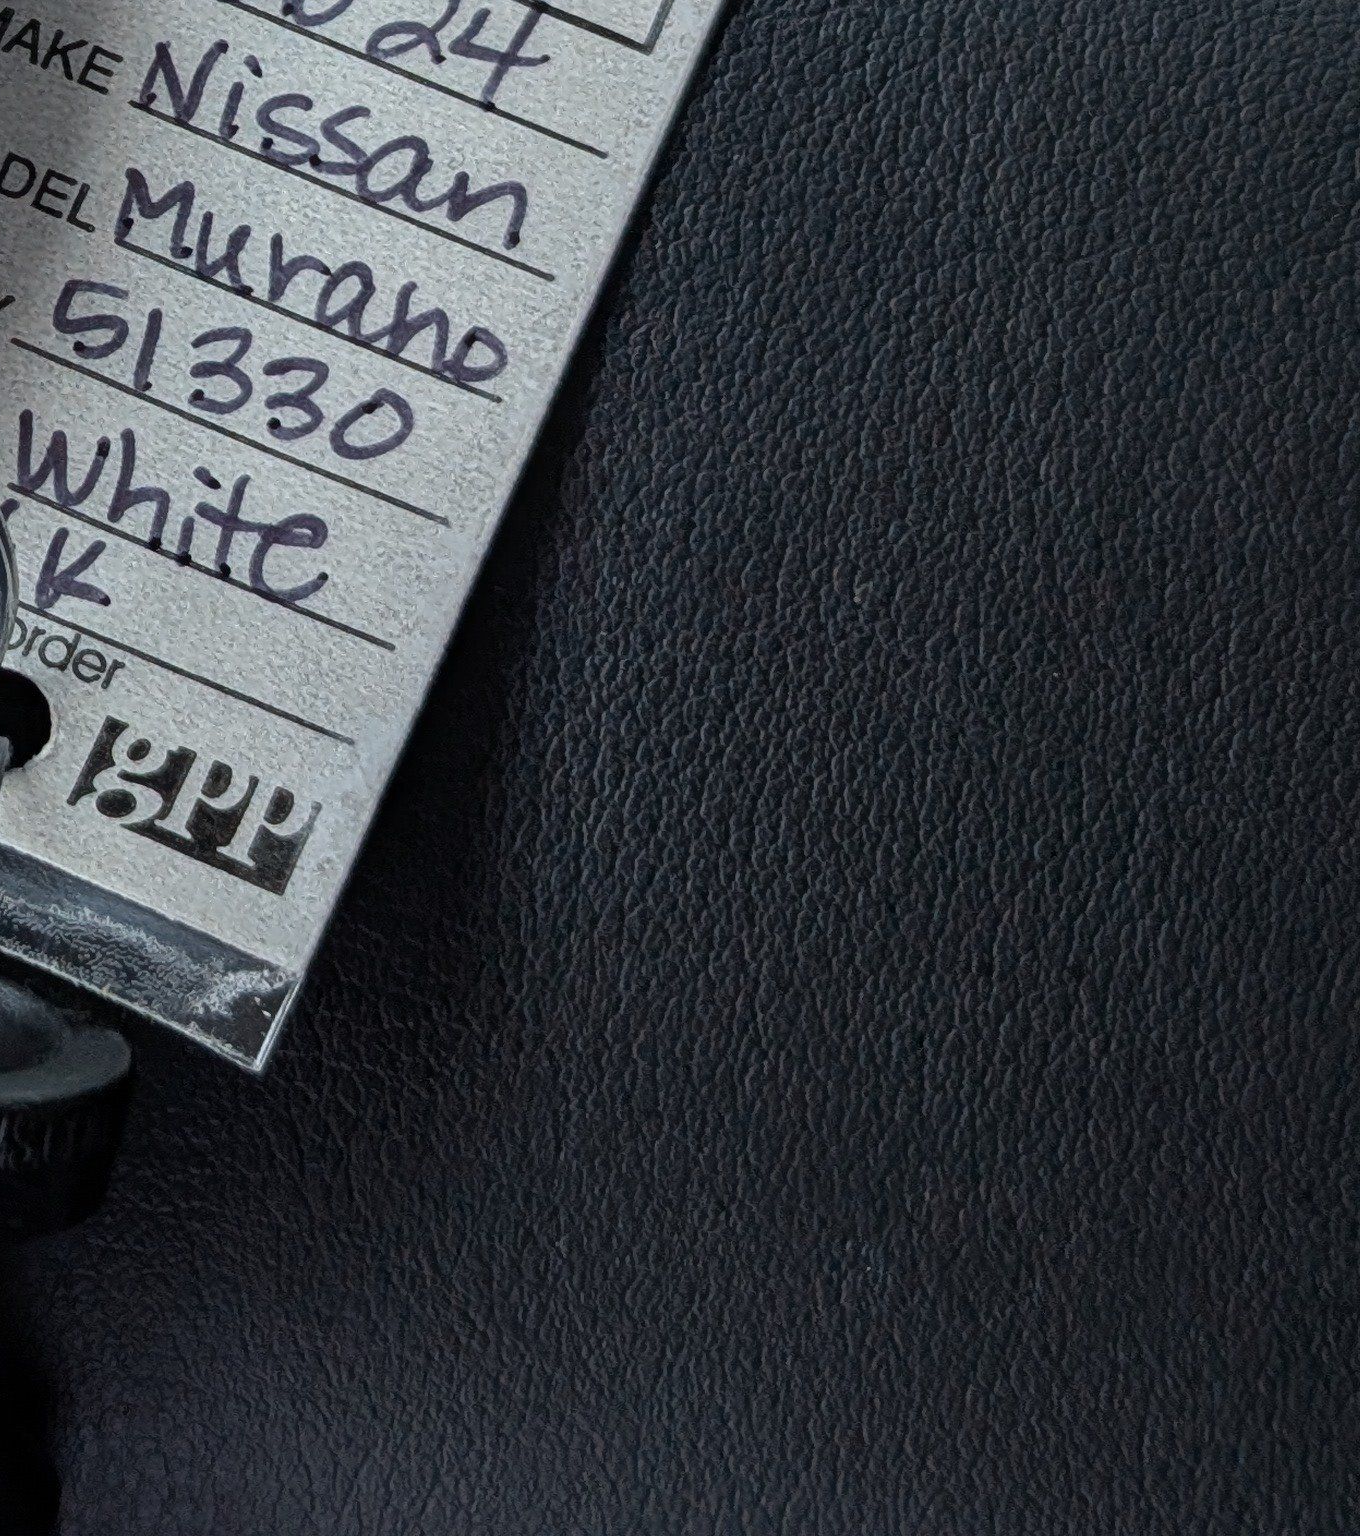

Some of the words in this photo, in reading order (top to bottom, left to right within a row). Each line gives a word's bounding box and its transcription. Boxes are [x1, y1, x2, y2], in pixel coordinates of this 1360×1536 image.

[139, 38, 530, 250] Nissan
[52, 278, 415, 462] 51330
[114, 166, 508, 384] Murano
[17, 409, 331, 603] White
